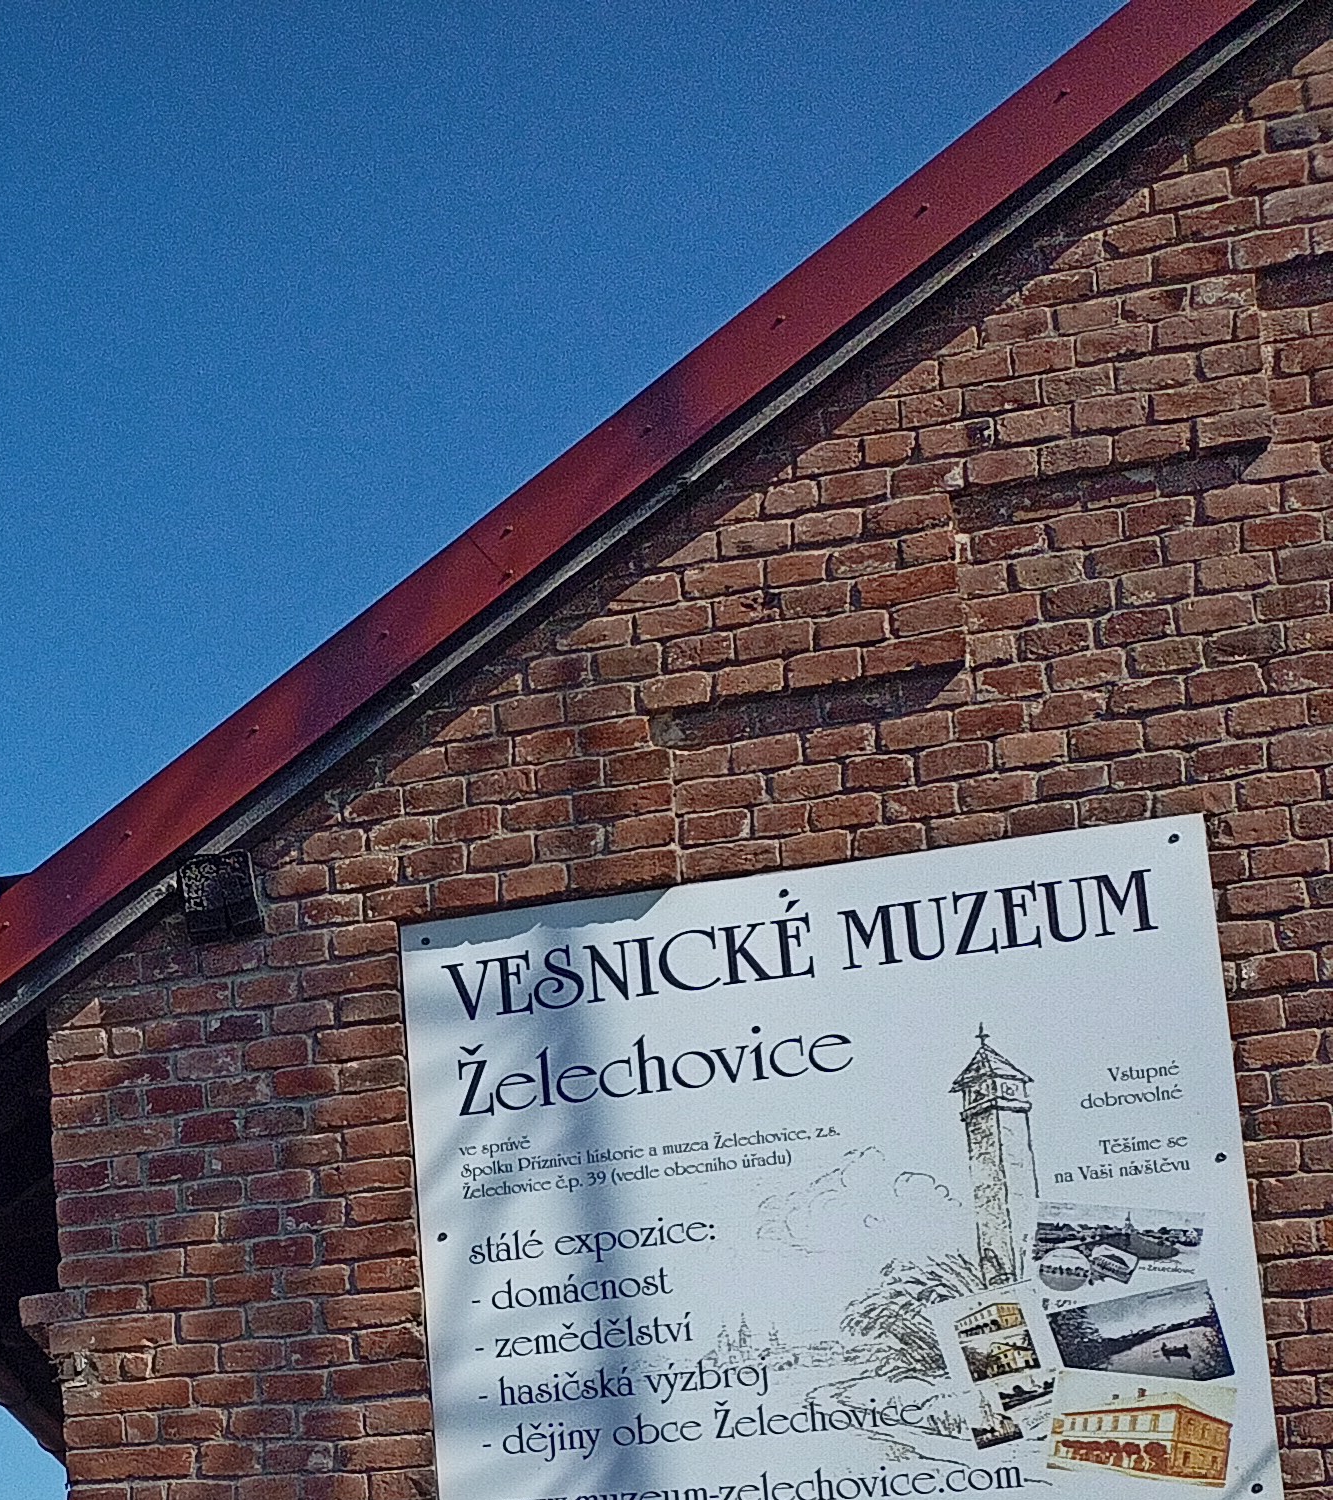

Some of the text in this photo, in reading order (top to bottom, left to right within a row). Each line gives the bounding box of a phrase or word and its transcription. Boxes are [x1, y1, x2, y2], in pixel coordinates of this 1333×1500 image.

[441, 868, 1159, 1021] VESNICKÉ MUZEUM
[458, 1025, 853, 1117] Želechovice
[1107, 1059, 1180, 1083] Vstupné
[1080, 1084, 1183, 1109] dobrovolné
[459, 1135, 531, 1158] ve správě
[460, 1159, 513, 1181] Spolku
[518, 1151, 582, 1172] Příznivci
[587, 1145, 644, 1164] historie
[649, 1146, 658, 1157] a
[663, 1140, 709, 1155] muzea
[1098, 1136, 1189, 1154] Těšíme se
[463, 1178, 552, 1199] Želechovice
[555, 1175, 583, 1193] č.p.
[588, 1170, 606, 1186] 39
[611, 1165, 660, 1186] (vedle
[742, 1149, 792, 1169] úřadu)
[1054, 1158, 1190, 1183] na Vaši návštěvu
[468, 1217, 717, 1265] stálé expozice:
[491, 1266, 674, 1310] domácnost
[494, 1311, 694, 1358] zemědělství
[498, 1367, 636, 1407] hasičská
[644, 1356, 769, 1405] výzbroj
[502, 1421, 602, 1462] dějiny
[612, 1413, 703, 1446] obce
[714, 1398, 925, 1440] Želechovice
